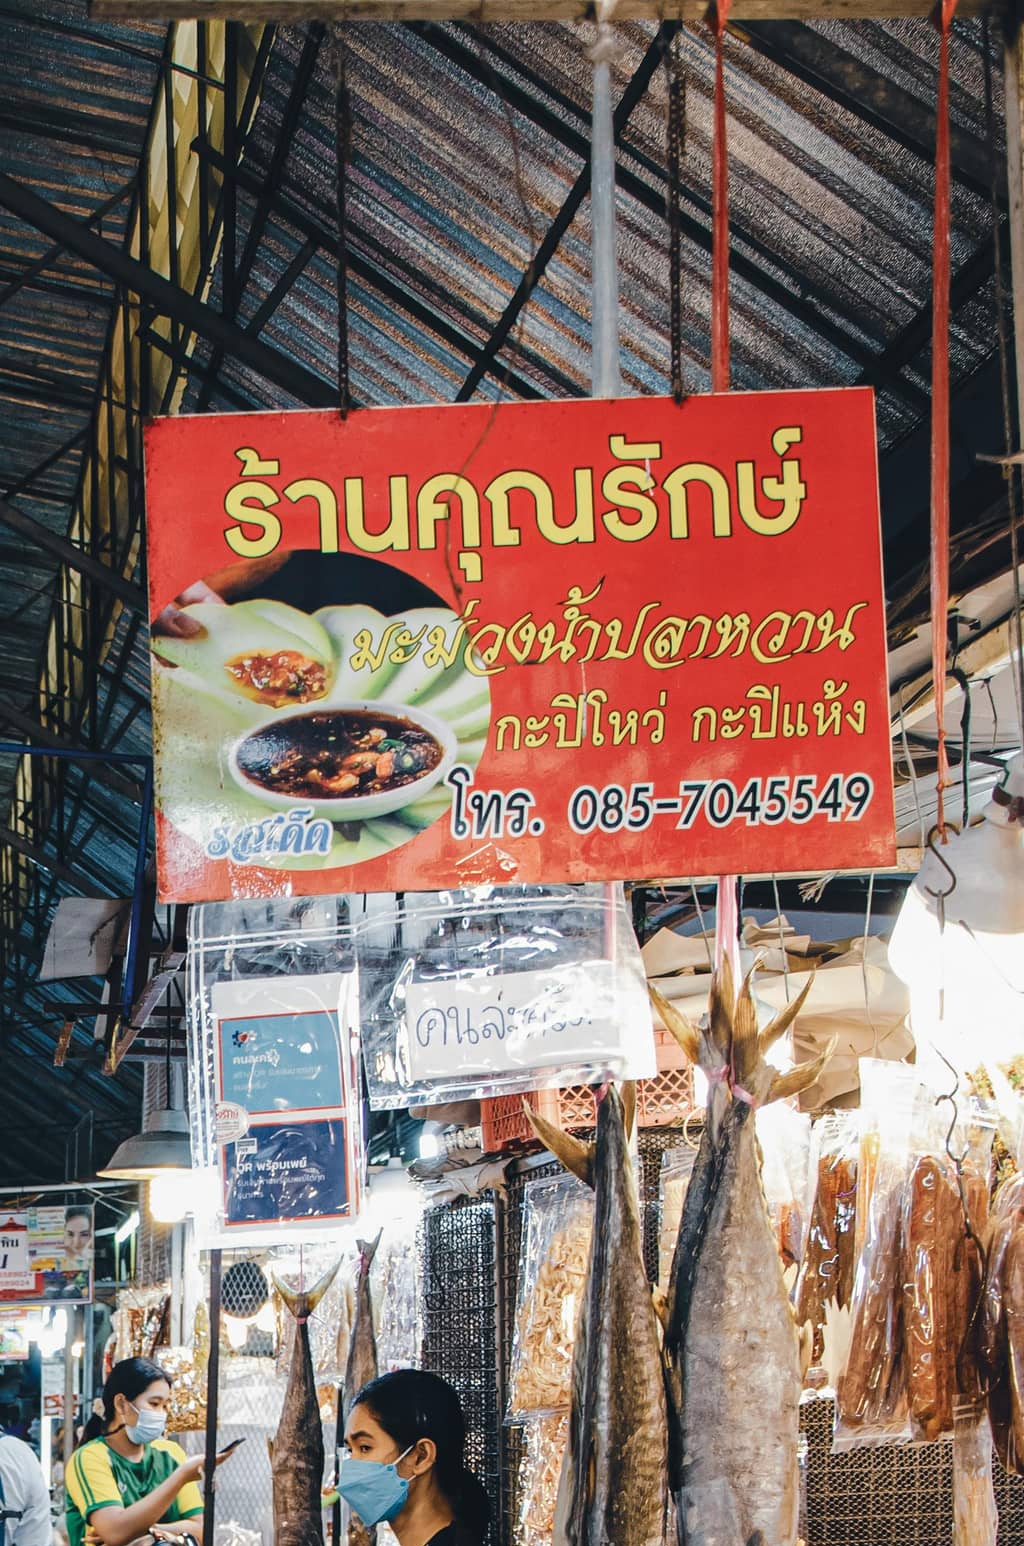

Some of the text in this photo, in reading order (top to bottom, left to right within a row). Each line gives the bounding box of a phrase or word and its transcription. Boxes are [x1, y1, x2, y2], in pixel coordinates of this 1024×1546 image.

[223, 426, 807, 582] ร้านคุณรักษ์
[349, 575, 870, 676] มะม่วงน้ำปลาหวาน
[448, 766, 873, 839] โทร. 085-7045549
[238, 1162, 253, 1174] QR
